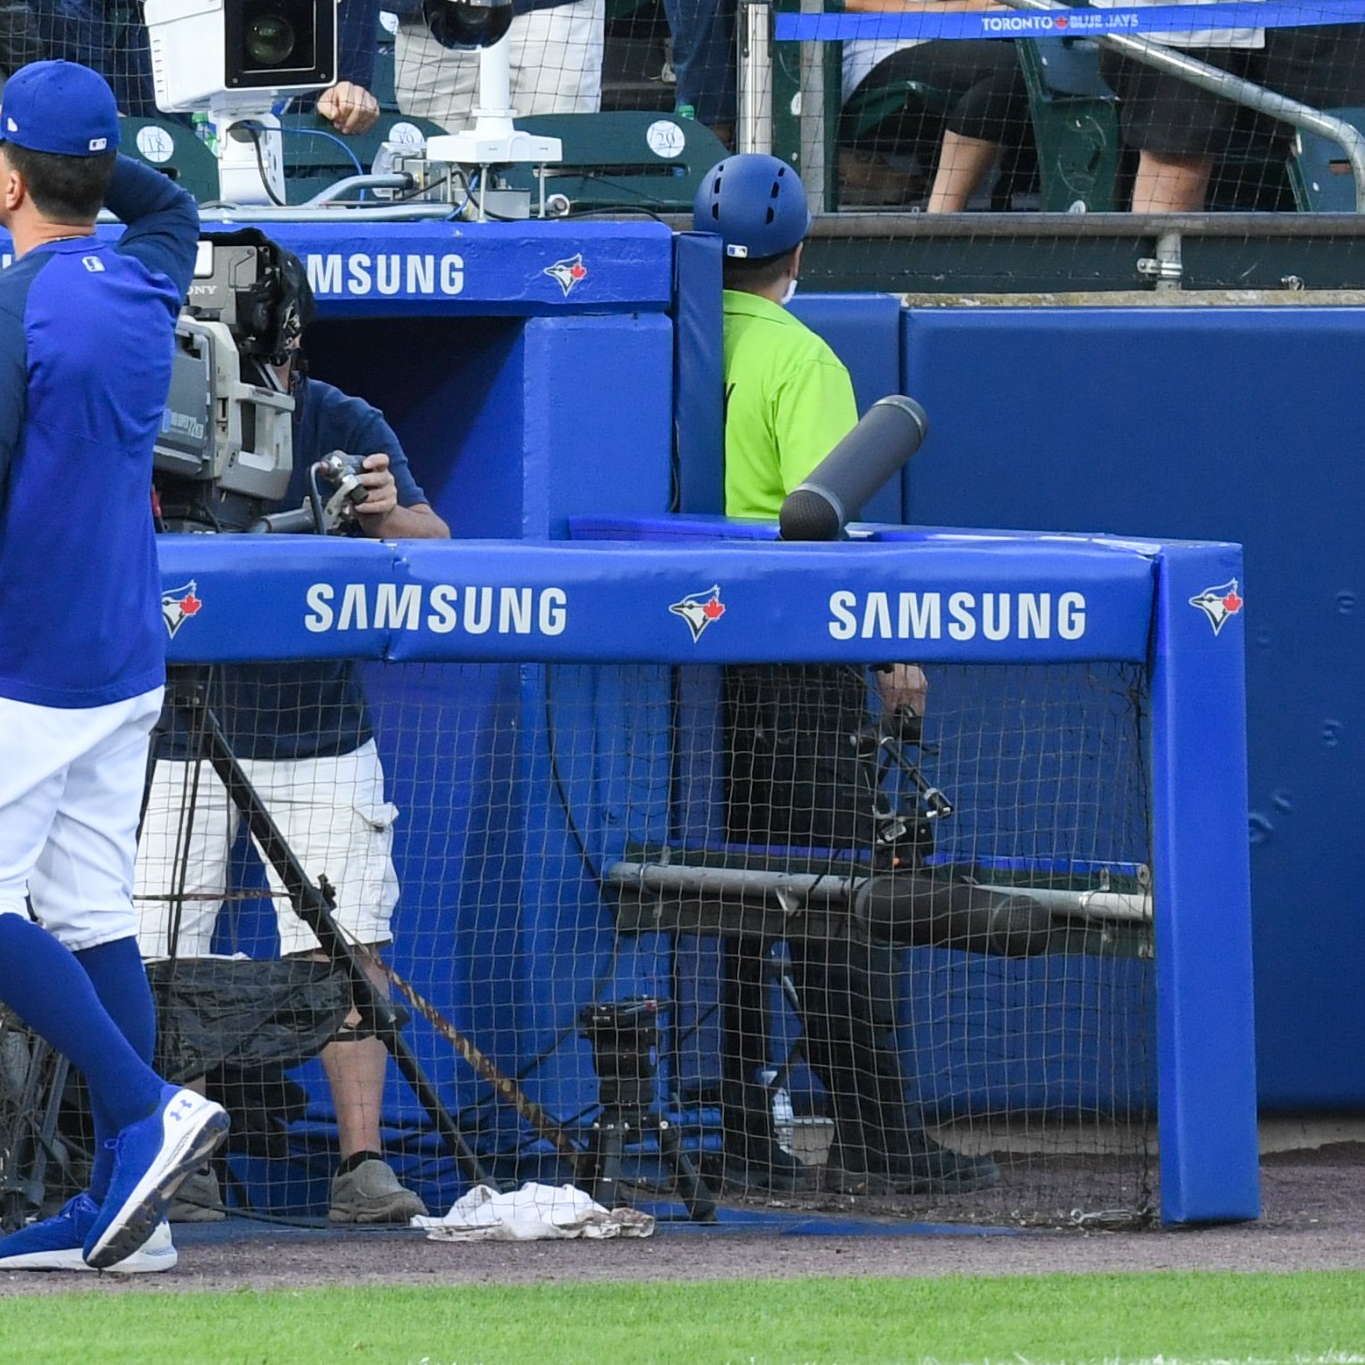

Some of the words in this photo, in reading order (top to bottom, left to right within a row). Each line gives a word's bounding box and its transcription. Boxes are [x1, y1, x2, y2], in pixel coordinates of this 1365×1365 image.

[983, 17, 1053, 32] TORONTO
[1070, 15, 1103, 30] BLUE
[1106, 14, 1140, 28] JAYS
[306, 253, 465, 296] MSUNG
[304, 583, 567, 637] SAMSUNG
[829, 591, 1087, 641] SAMSUNG
